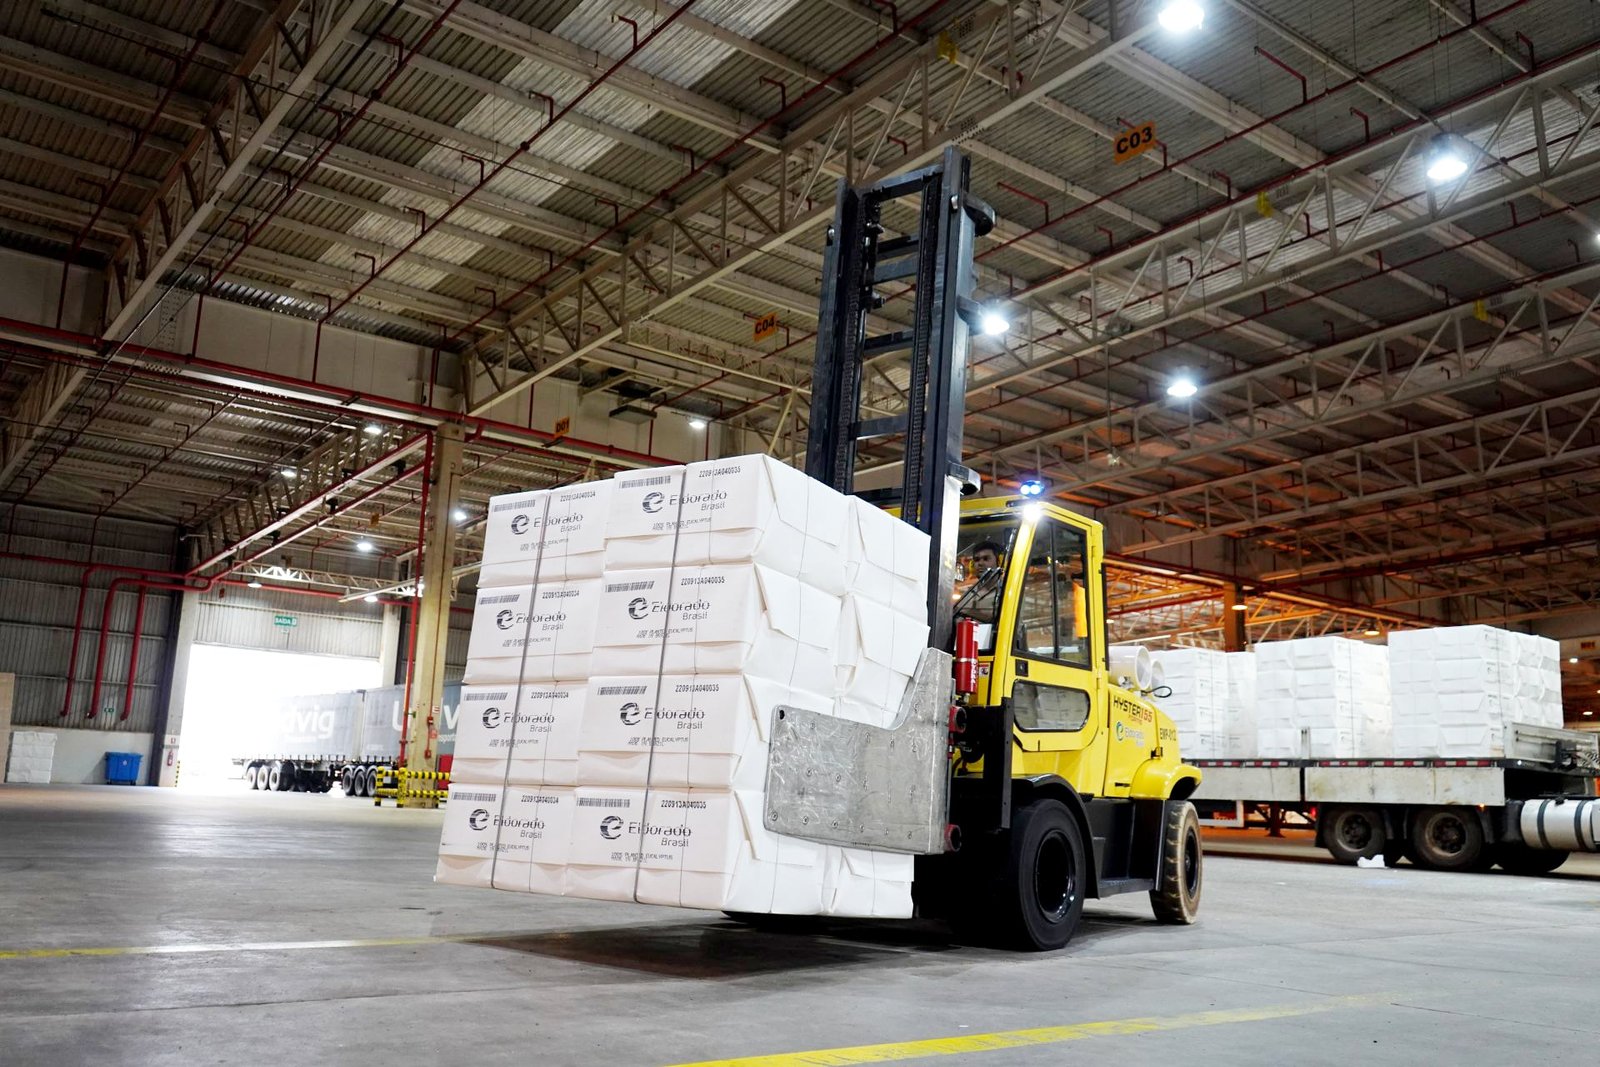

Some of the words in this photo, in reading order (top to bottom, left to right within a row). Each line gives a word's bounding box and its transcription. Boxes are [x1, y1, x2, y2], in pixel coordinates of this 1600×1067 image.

[669, 489, 727, 506] Edorado
[701, 501, 726, 511] Brasil
[533, 512, 584, 528] Edorado
[560, 524, 582, 533] Brasil
[682, 611, 709, 621] Brasil
[1113, 696, 1141, 719] HYSTER
[643, 707, 705, 720] Edorado
[529, 724, 553, 733] Brasil
[676, 720, 703, 730] Brasil
[520, 829, 543, 839] Brasil
[660, 837, 690, 848] Brasil
